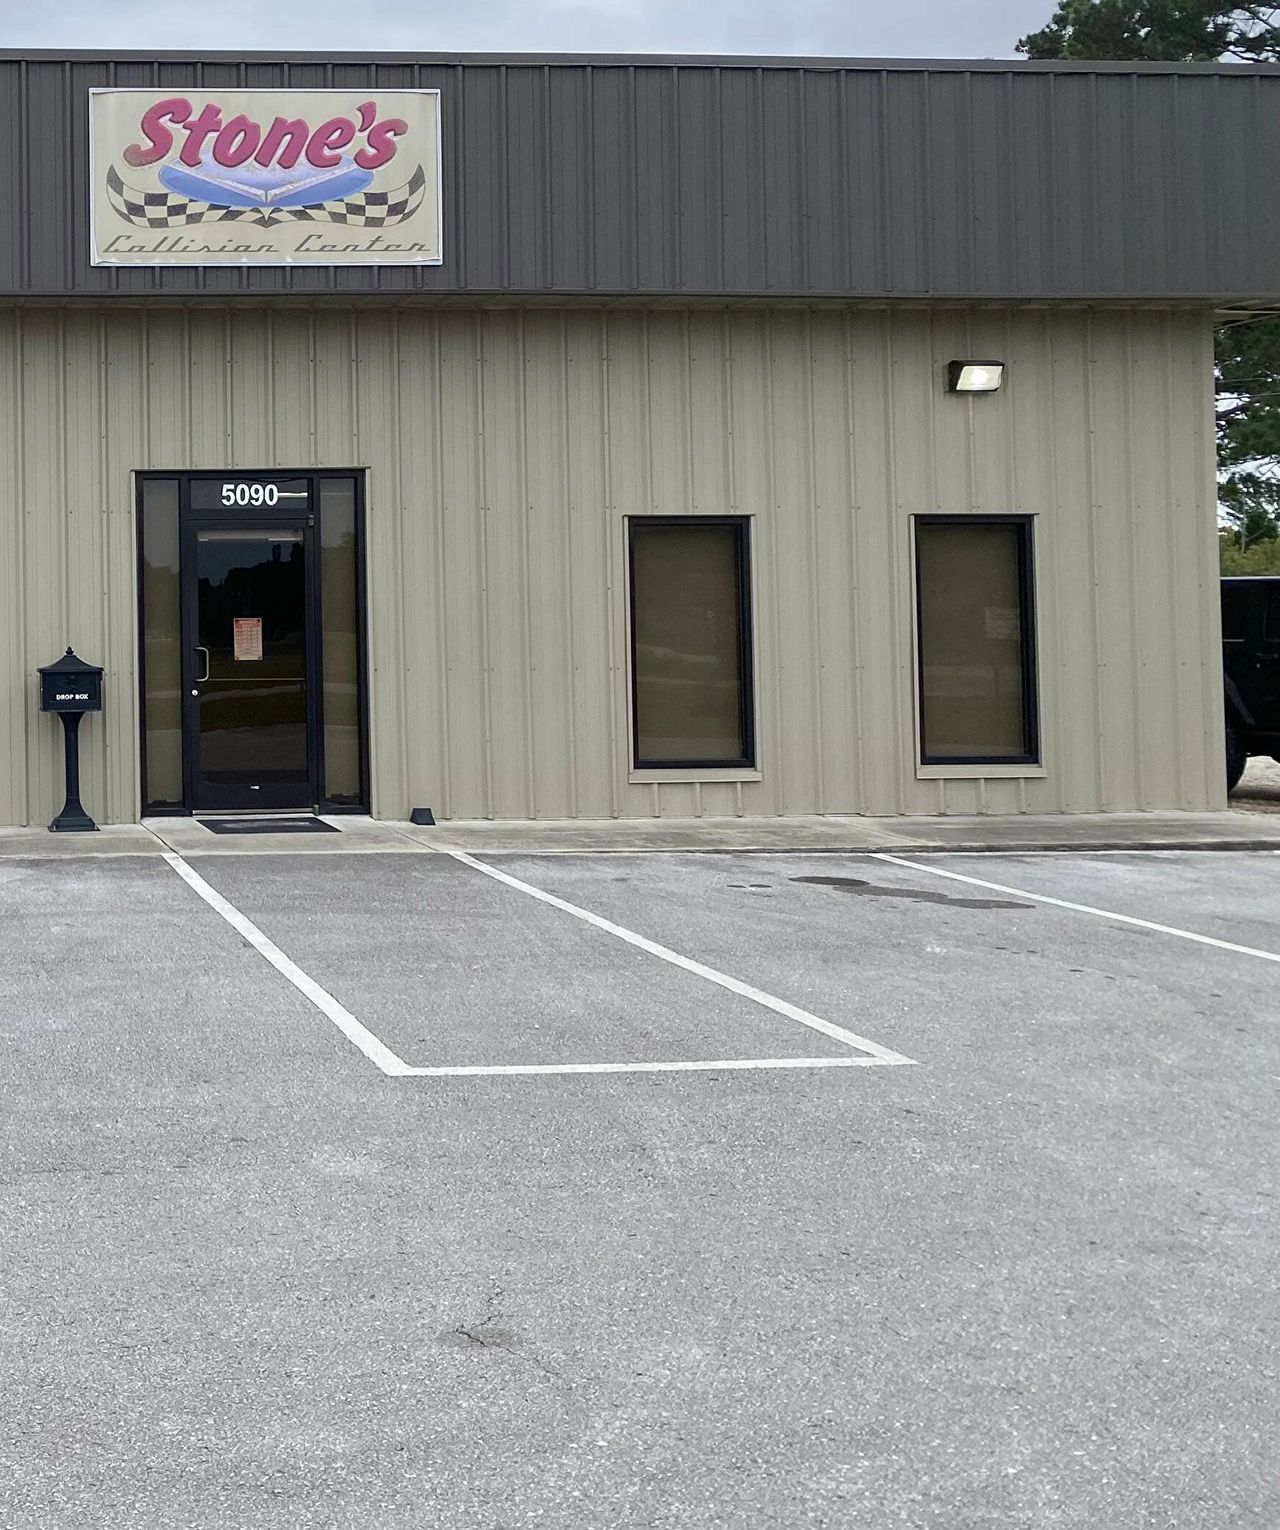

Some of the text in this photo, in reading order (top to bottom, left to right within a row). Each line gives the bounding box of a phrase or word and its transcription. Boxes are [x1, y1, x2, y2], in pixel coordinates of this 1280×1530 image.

[123, 98, 409, 170] Stone's
[102, 233, 432, 253] Collision Center
[221, 483, 279, 506] 5090
